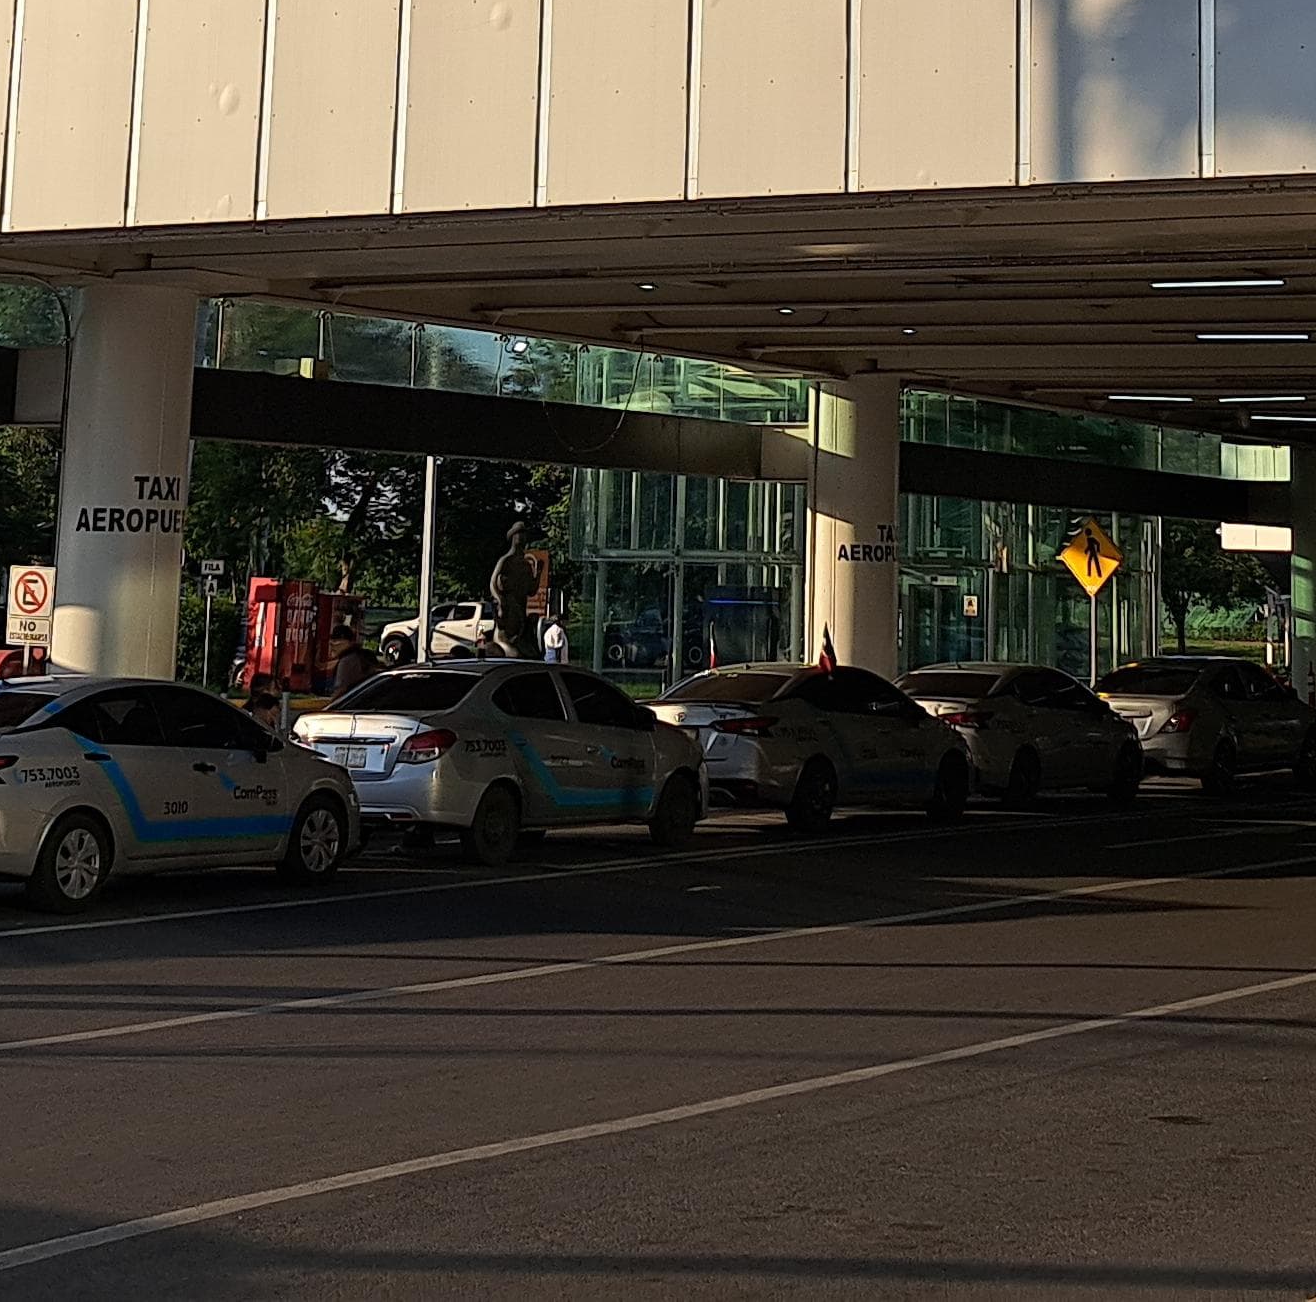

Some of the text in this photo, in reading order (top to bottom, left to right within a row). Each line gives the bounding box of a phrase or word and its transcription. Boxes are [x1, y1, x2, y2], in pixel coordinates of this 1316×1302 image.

[134, 476, 180, 501] TAXI
[208, 582, 215, 592] A
[19, 620, 37, 632] NO
[20, 766, 80, 783] 753.7003
[163, 801, 189, 815] 3010
